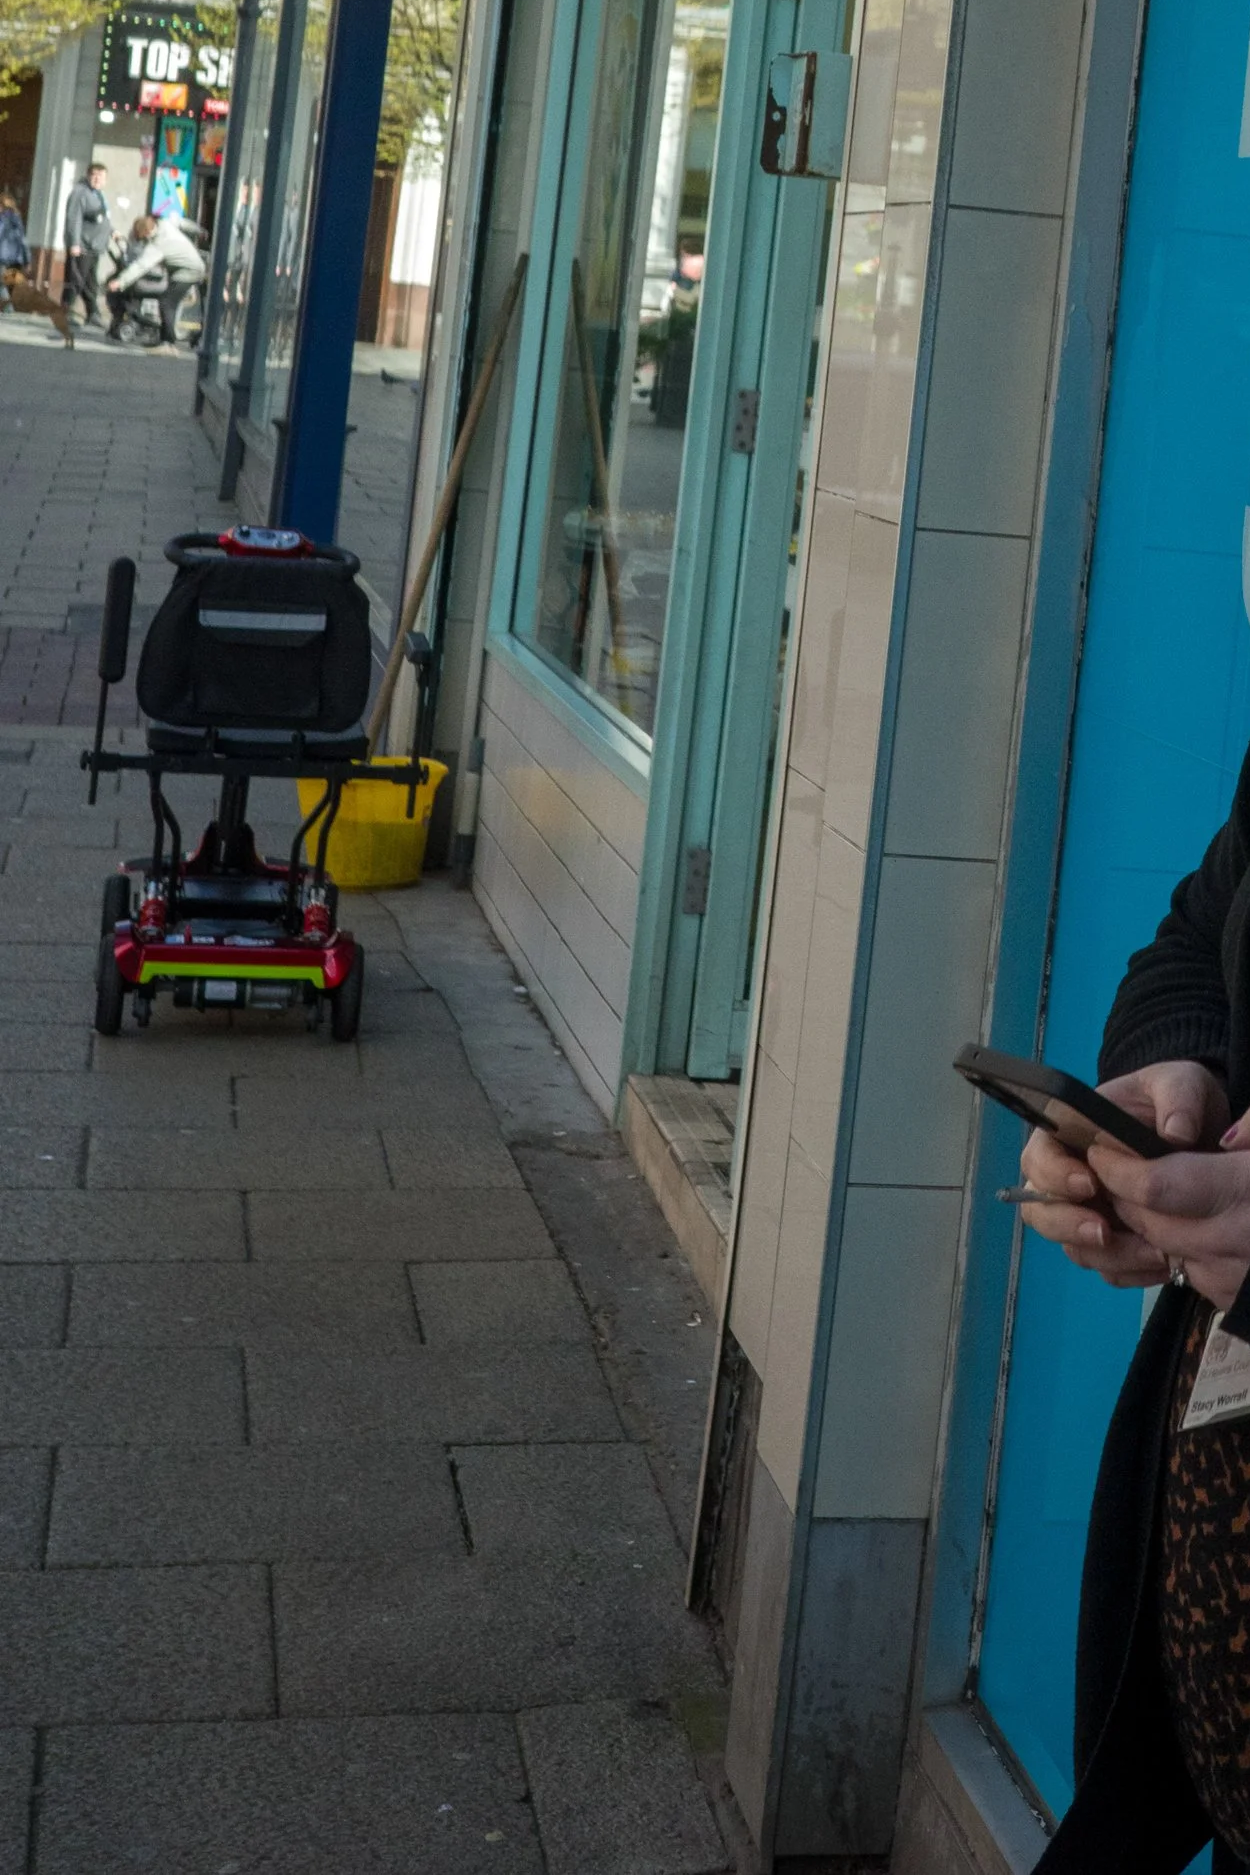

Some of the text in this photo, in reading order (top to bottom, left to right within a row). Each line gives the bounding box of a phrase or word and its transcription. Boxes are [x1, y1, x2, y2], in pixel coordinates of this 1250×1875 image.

[126, 36, 192, 83] TOP
[1190, 1388, 1249, 1414] Stacy Worrall
